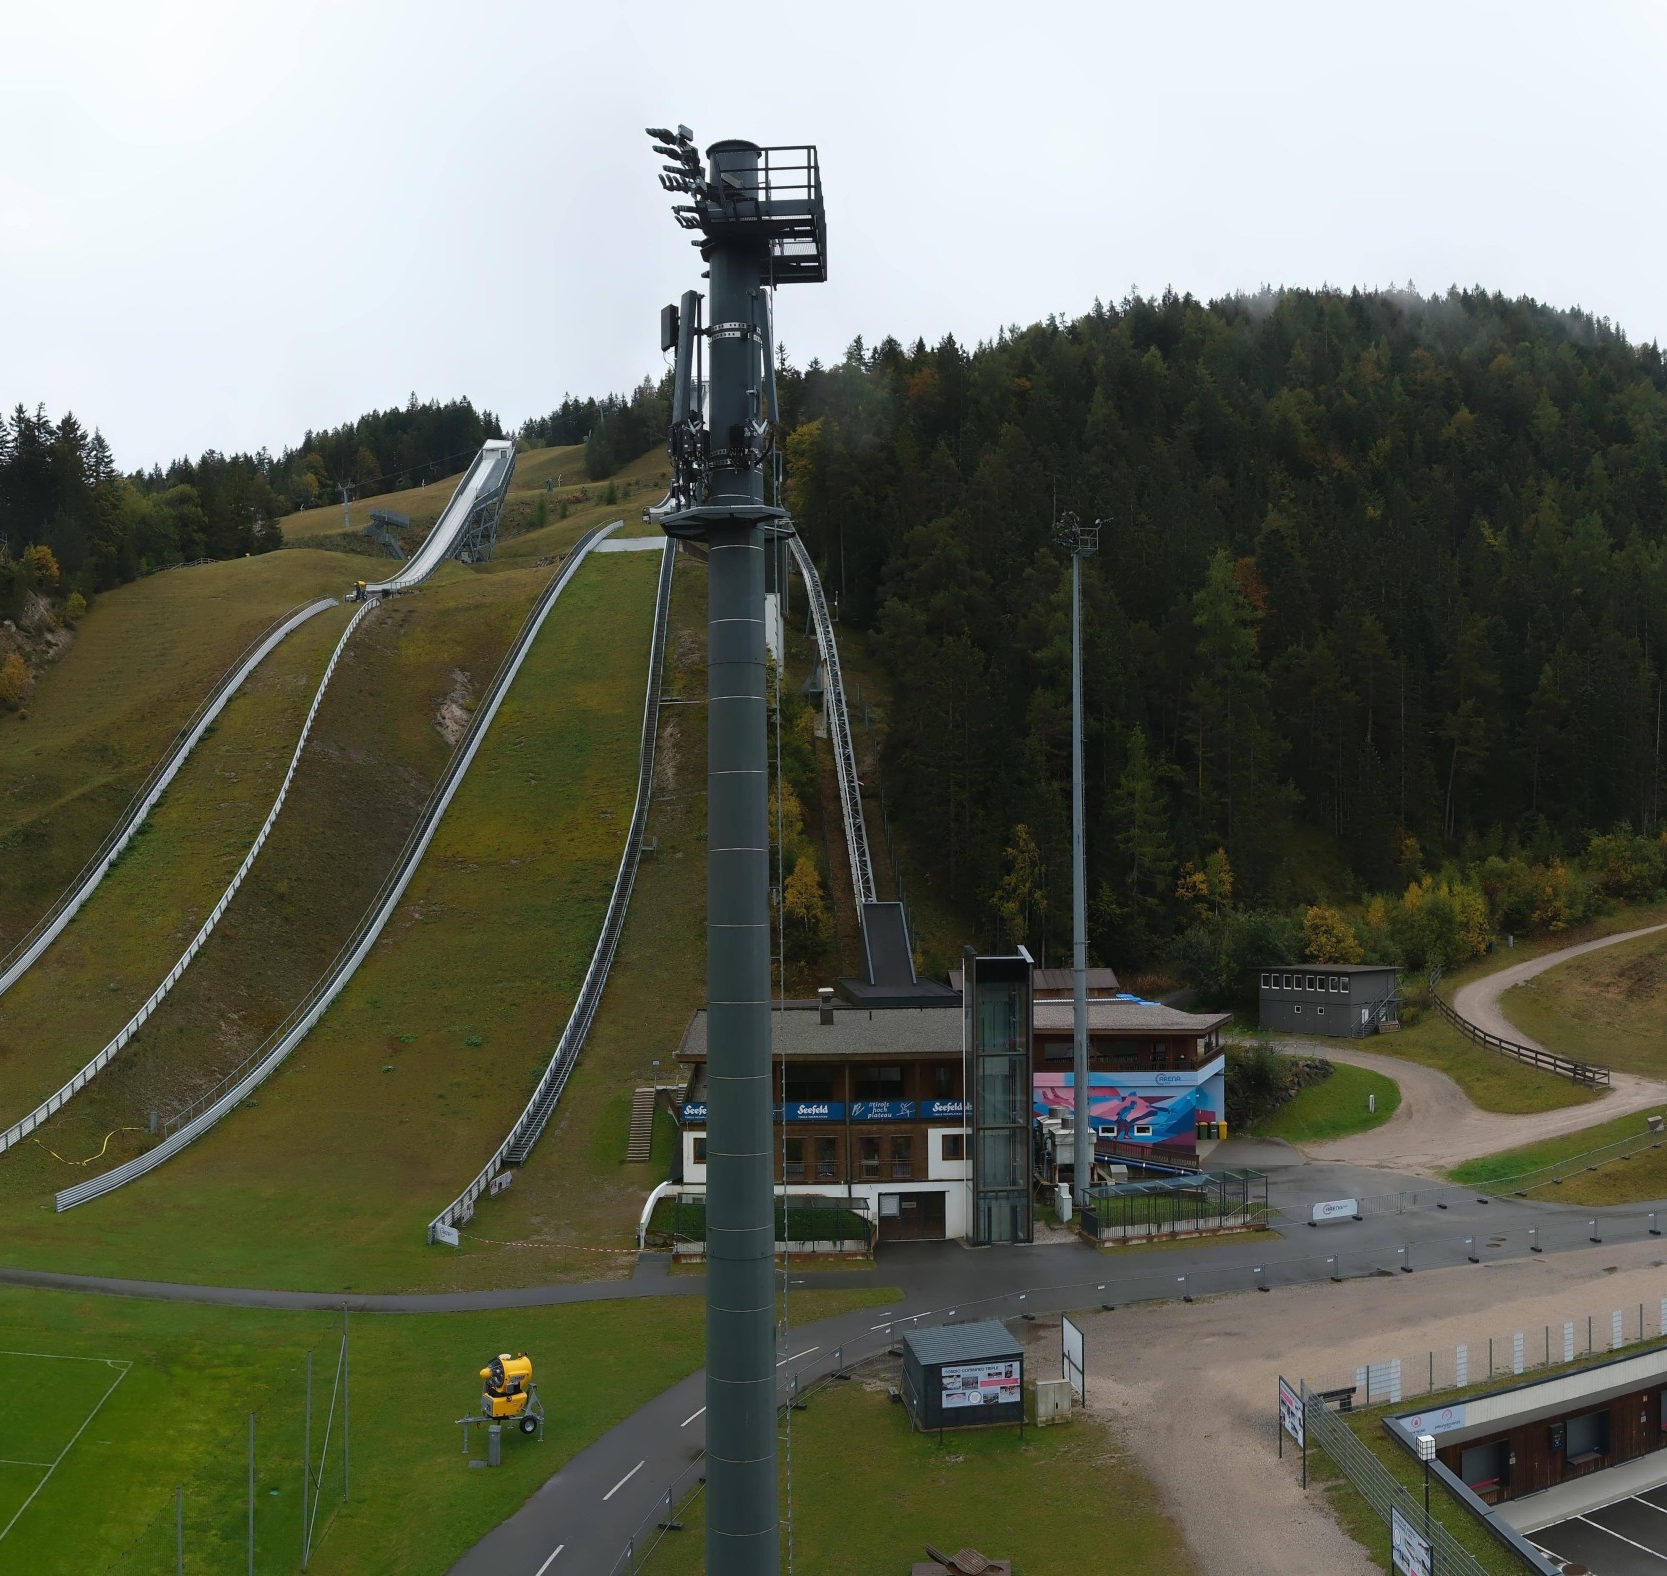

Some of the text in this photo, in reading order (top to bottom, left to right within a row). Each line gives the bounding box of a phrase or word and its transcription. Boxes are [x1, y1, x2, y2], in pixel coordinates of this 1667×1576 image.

[684, 1105, 707, 1115] Seefe
[797, 1104, 828, 1115] Seefeld
[932, 1102, 962, 1112] Seefeld
